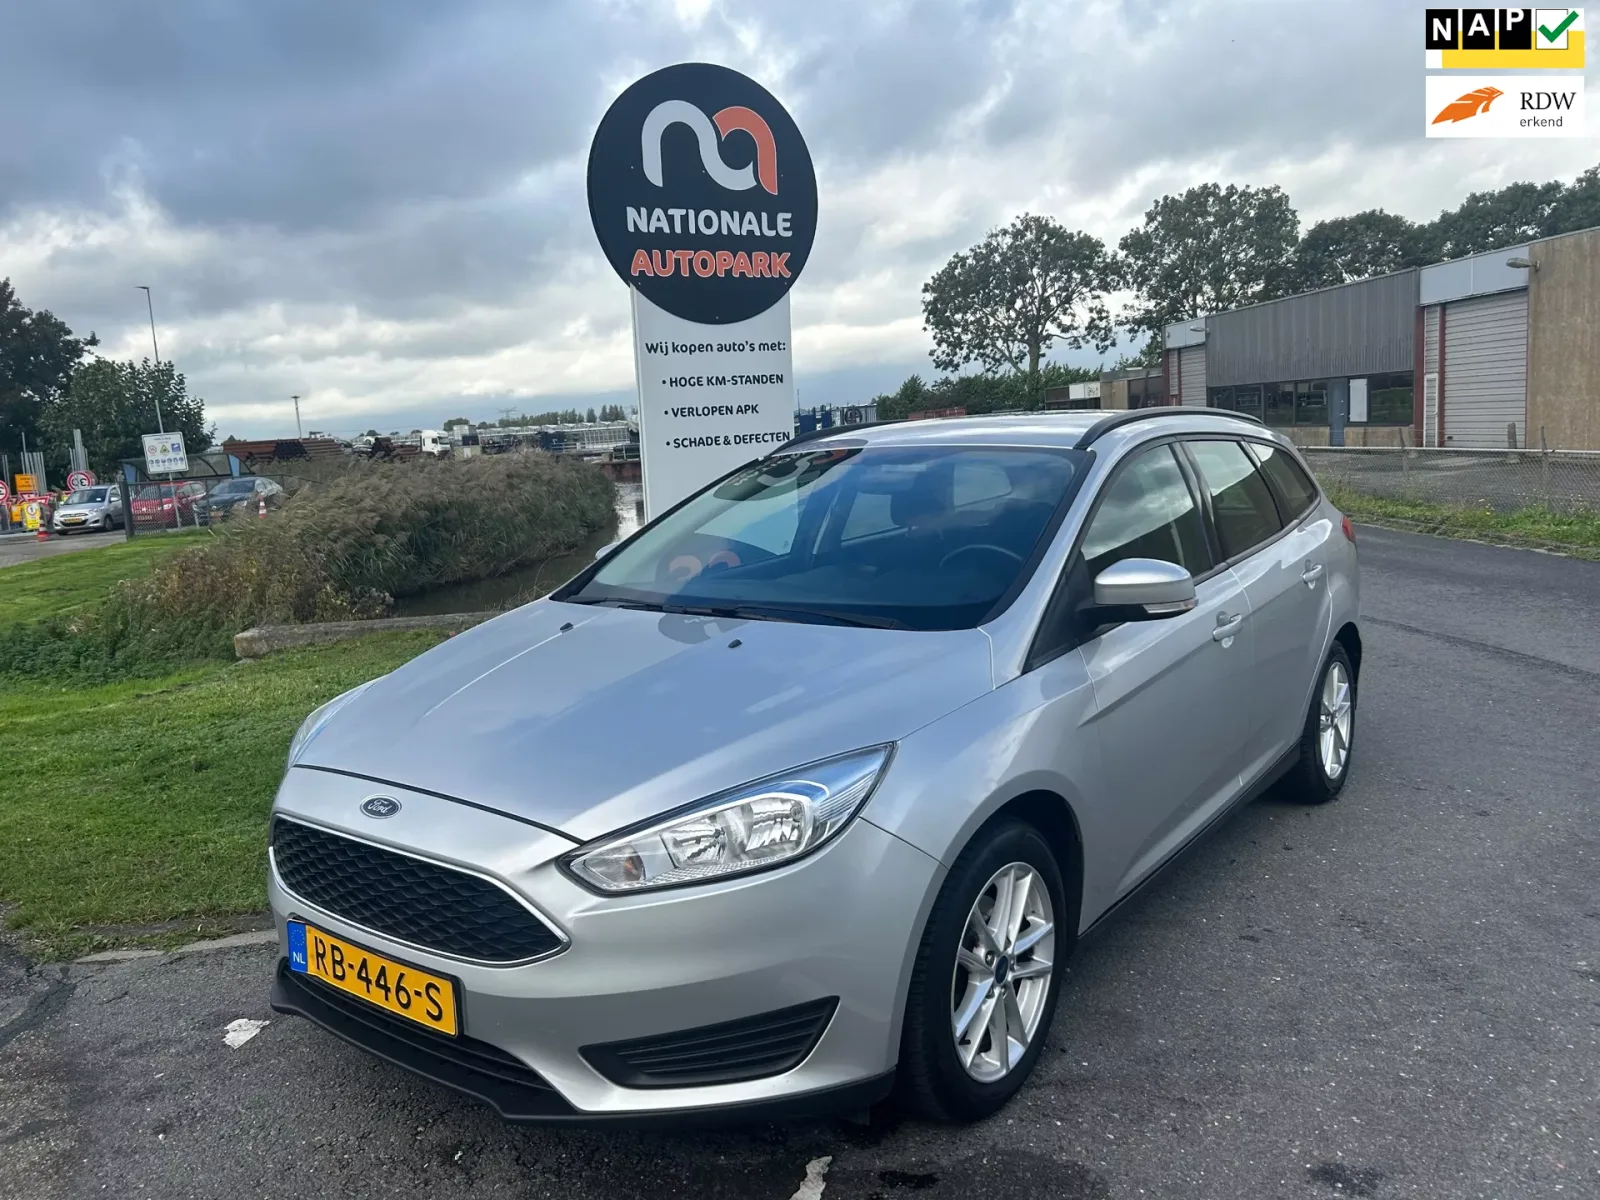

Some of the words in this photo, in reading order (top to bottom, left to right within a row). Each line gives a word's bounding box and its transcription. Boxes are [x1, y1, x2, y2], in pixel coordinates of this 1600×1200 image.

[626, 206, 793, 237] NATIONALE
[630, 249, 792, 279] AUTOPARK
[645, 342, 668, 356] Wij
[671, 341, 713, 355] kopen
[716, 340, 755, 353] auto's
[758, 341, 786, 352] met:
[669, 376, 703, 387] HOGE
[706, 374, 784, 386] KM-STANDEN
[671, 405, 733, 417] VERLOPEN
[735, 404, 759, 415] APK
[673, 436, 721, 448] SCHADE
[723, 435, 731, 445] &
[733, 431, 790, 445] DEFECTEN
[367, 798, 393, 814] Ford
[292, 951, 306, 965] NL
[314, 935, 443, 1022] RB-446-S
